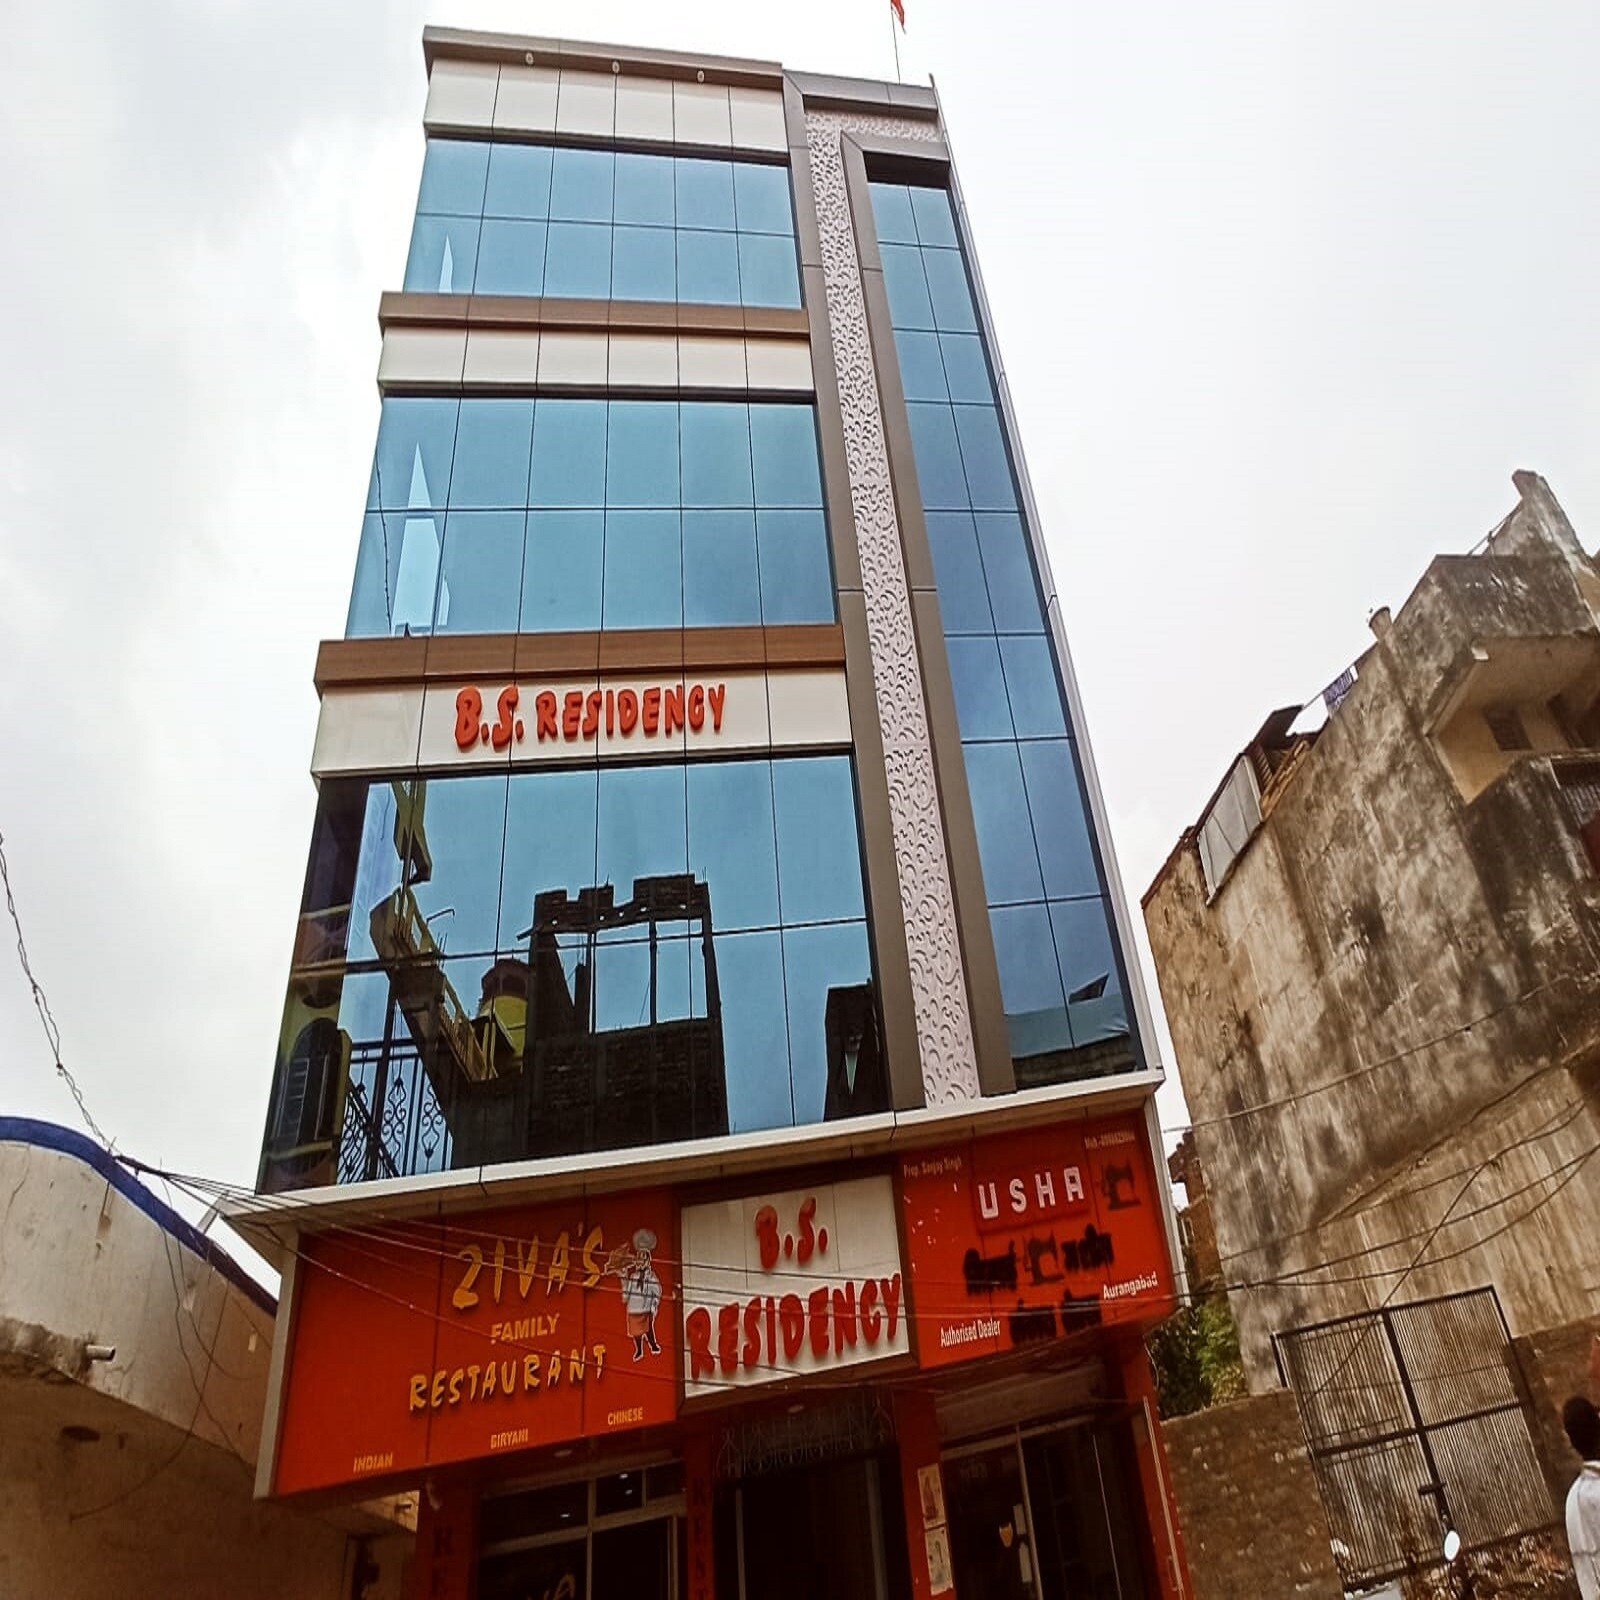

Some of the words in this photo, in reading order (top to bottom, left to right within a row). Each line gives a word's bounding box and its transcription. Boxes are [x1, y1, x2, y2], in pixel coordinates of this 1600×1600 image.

[455, 686, 524, 748] B.S.
[978, 1166, 1084, 1219] USHA
[755, 1197, 828, 1273] B.S.
[1103, 1271, 1158, 1300] Aurangabad
[490, 1313, 560, 1344] FAMILY
[685, 1273, 900, 1378] RESIDENCY
[940, 1321, 977, 1347] Authorised
[977, 1317, 1000, 1338] Dealer
[409, 1345, 606, 1411] RESTAURANT
[607, 1406, 644, 1426] CHINESE
[352, 1452, 393, 1474] INDIAN
